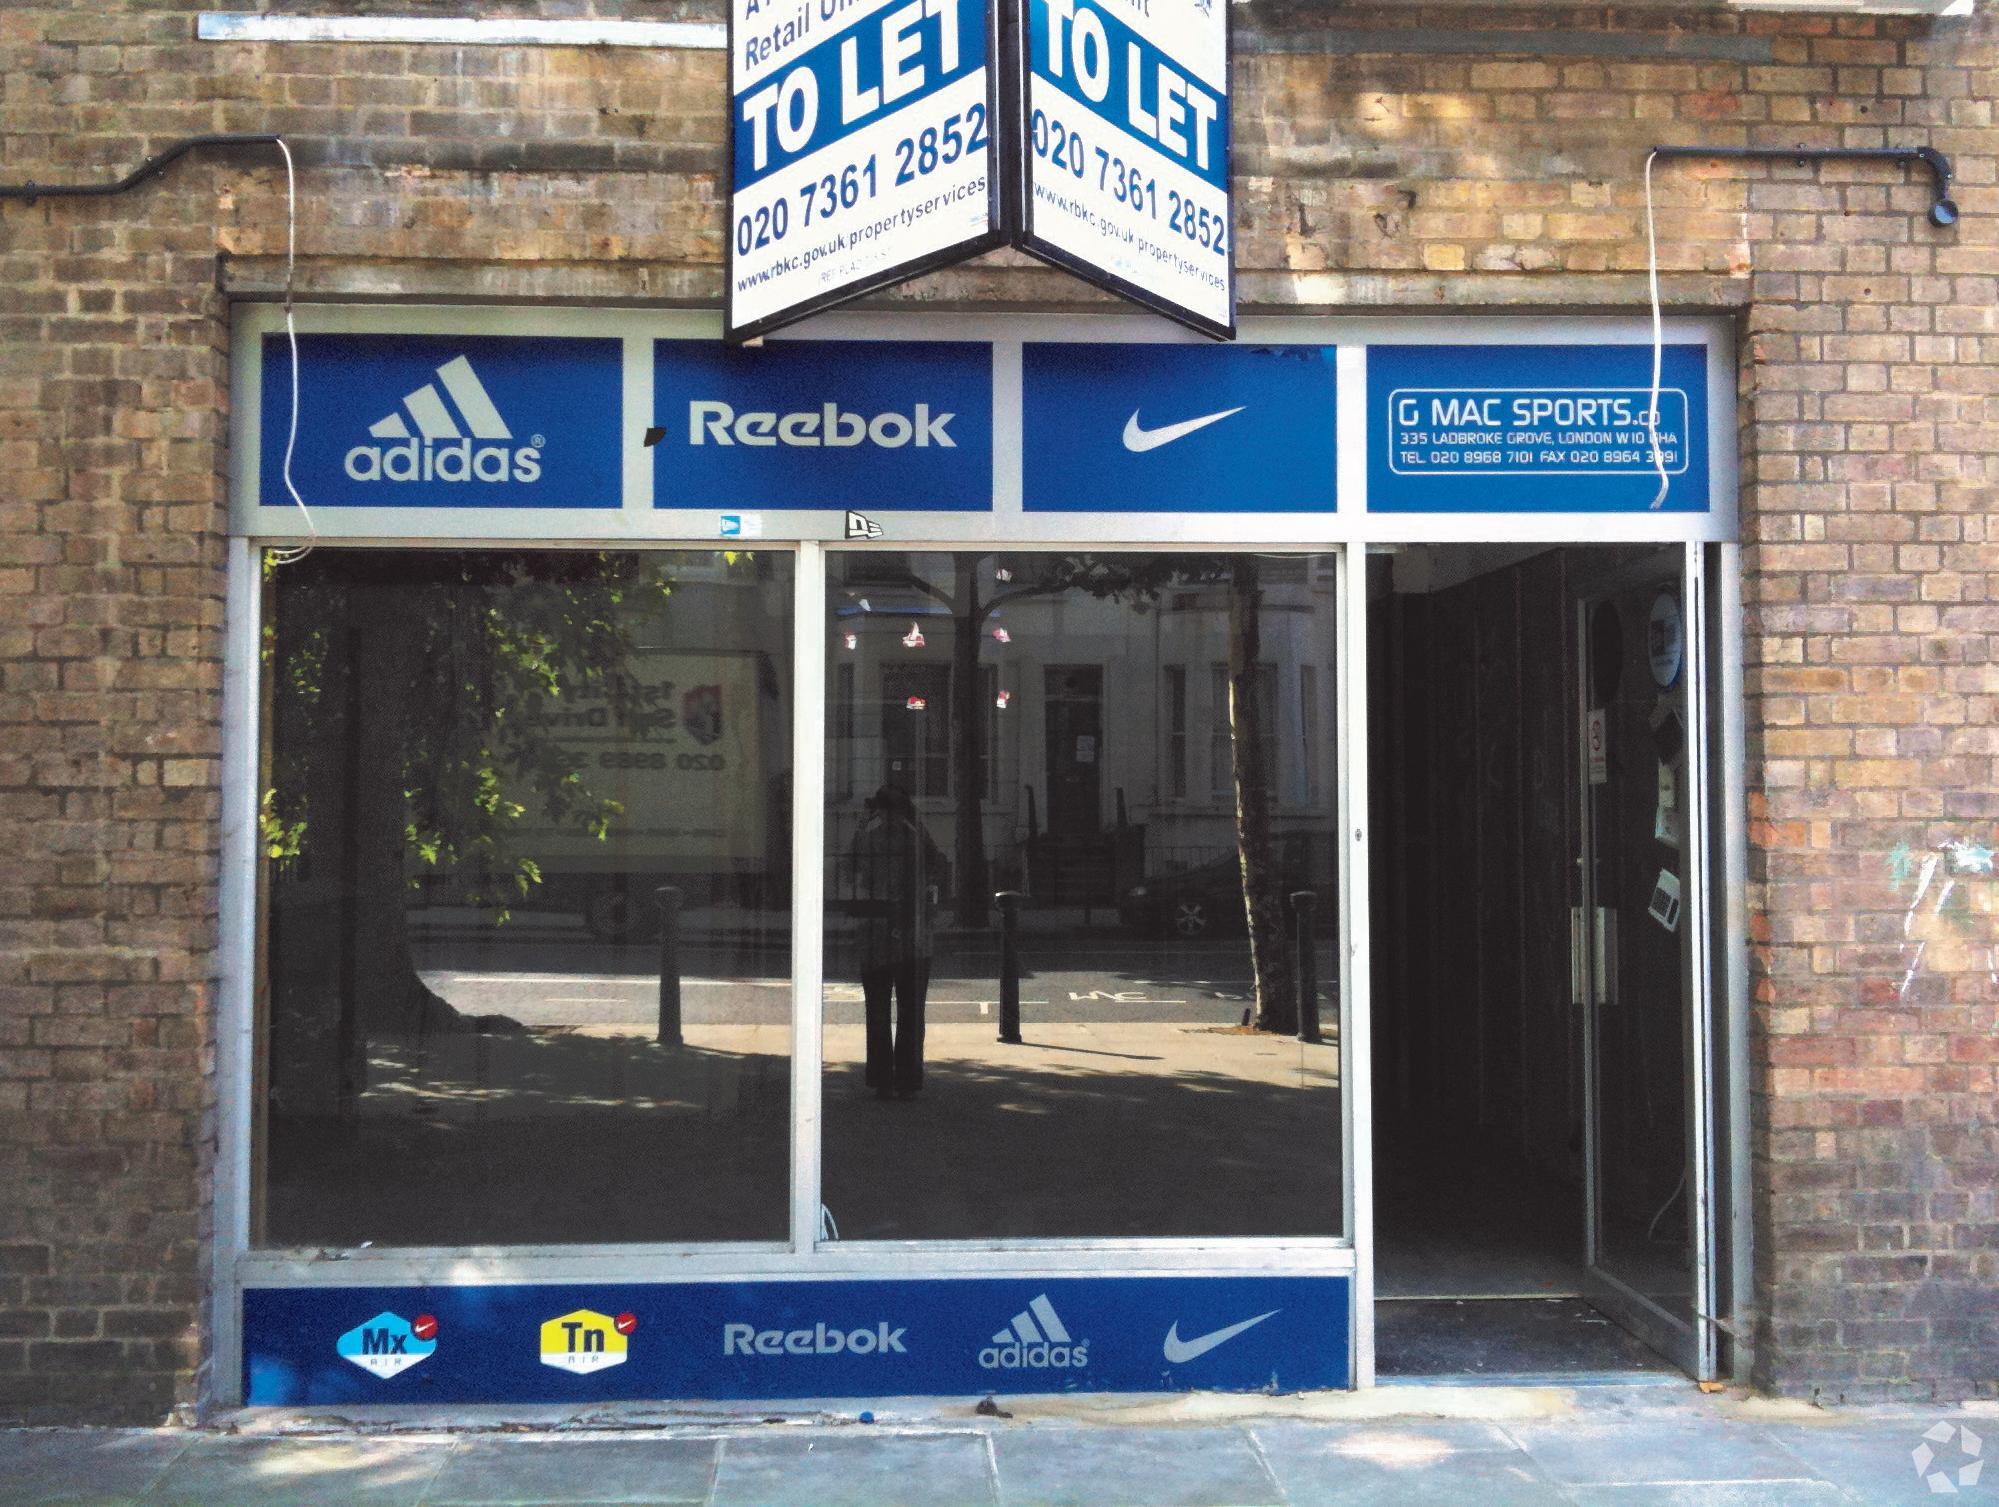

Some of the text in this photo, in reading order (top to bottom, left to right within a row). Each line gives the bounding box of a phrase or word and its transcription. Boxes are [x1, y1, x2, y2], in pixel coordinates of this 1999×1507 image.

[746, 2, 809, 71] Retail
[743, 0, 959, 172] TO LET
[1043, 0, 1217, 171] TO LET
[737, 102, 987, 256] 020 7361 2852
[1032, 108, 1225, 256] 020 7361 2852
[689, 400, 957, 448] Reebok
[1399, 399, 1419, 426] G
[1431, 398, 1502, 426] MAC
[1400, 432, 1428, 445] 335
[1432, 432, 1503, 445] LADBROKE
[1506, 432, 1555, 446] GROVE,
[1558, 431, 1613, 444] LONDON
[344, 437, 542, 483] adidas
[1431, 451, 1460, 464] 020
[1464, 451, 1502, 464] 8968
[1506, 451, 1533, 464] 7101
[1540, 451, 1566, 463] FAX
[1570, 450, 1599, 463] 020
[1603, 450, 1640, 463] 8964
[1645, 450, 1678, 463] 391
[362, 1328, 408, 1355] Mx
[561, 1322, 605, 1353] Tn
[724, 1322, 908, 1356] Reebok
[370, 1358, 401, 1366] AIR
[568, 1356, 599, 1364] AIR
[978, 1341, 1088, 1369] adidas
